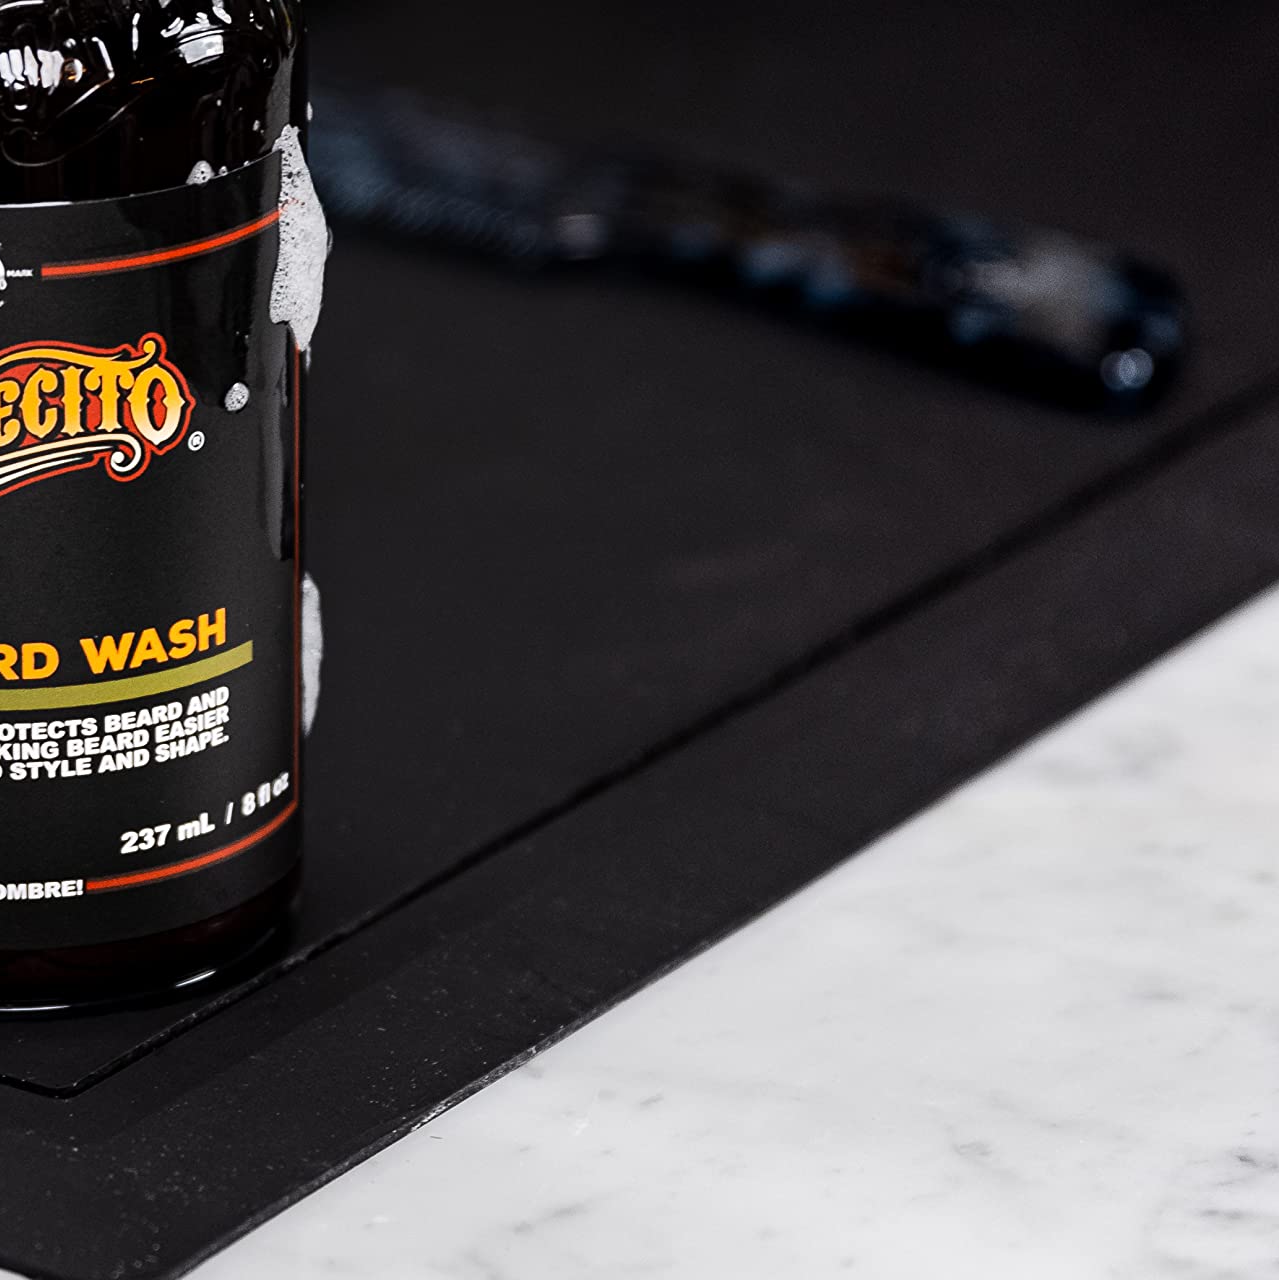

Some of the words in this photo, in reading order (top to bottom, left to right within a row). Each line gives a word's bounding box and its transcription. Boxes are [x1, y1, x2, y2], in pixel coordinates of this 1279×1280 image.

[6, 268, 34, 278] MARK
[80, 607, 226, 674] WASH
[67, 728, 149, 757] BEARD
[154, 706, 229, 741] EASIER
[104, 701, 183, 733] BEARD
[187, 686, 229, 714] AND
[9, 760, 92, 780] STYLE
[98, 750, 149, 773] AND
[155, 728, 229, 763] SHAPE.
[120, 824, 171, 854] 237
[178, 812, 215, 842] mL
[224, 802, 234, 824] /
[241, 791, 255, 816] 8
[257, 783, 272, 807] fl
[273, 771, 289, 798] oz
